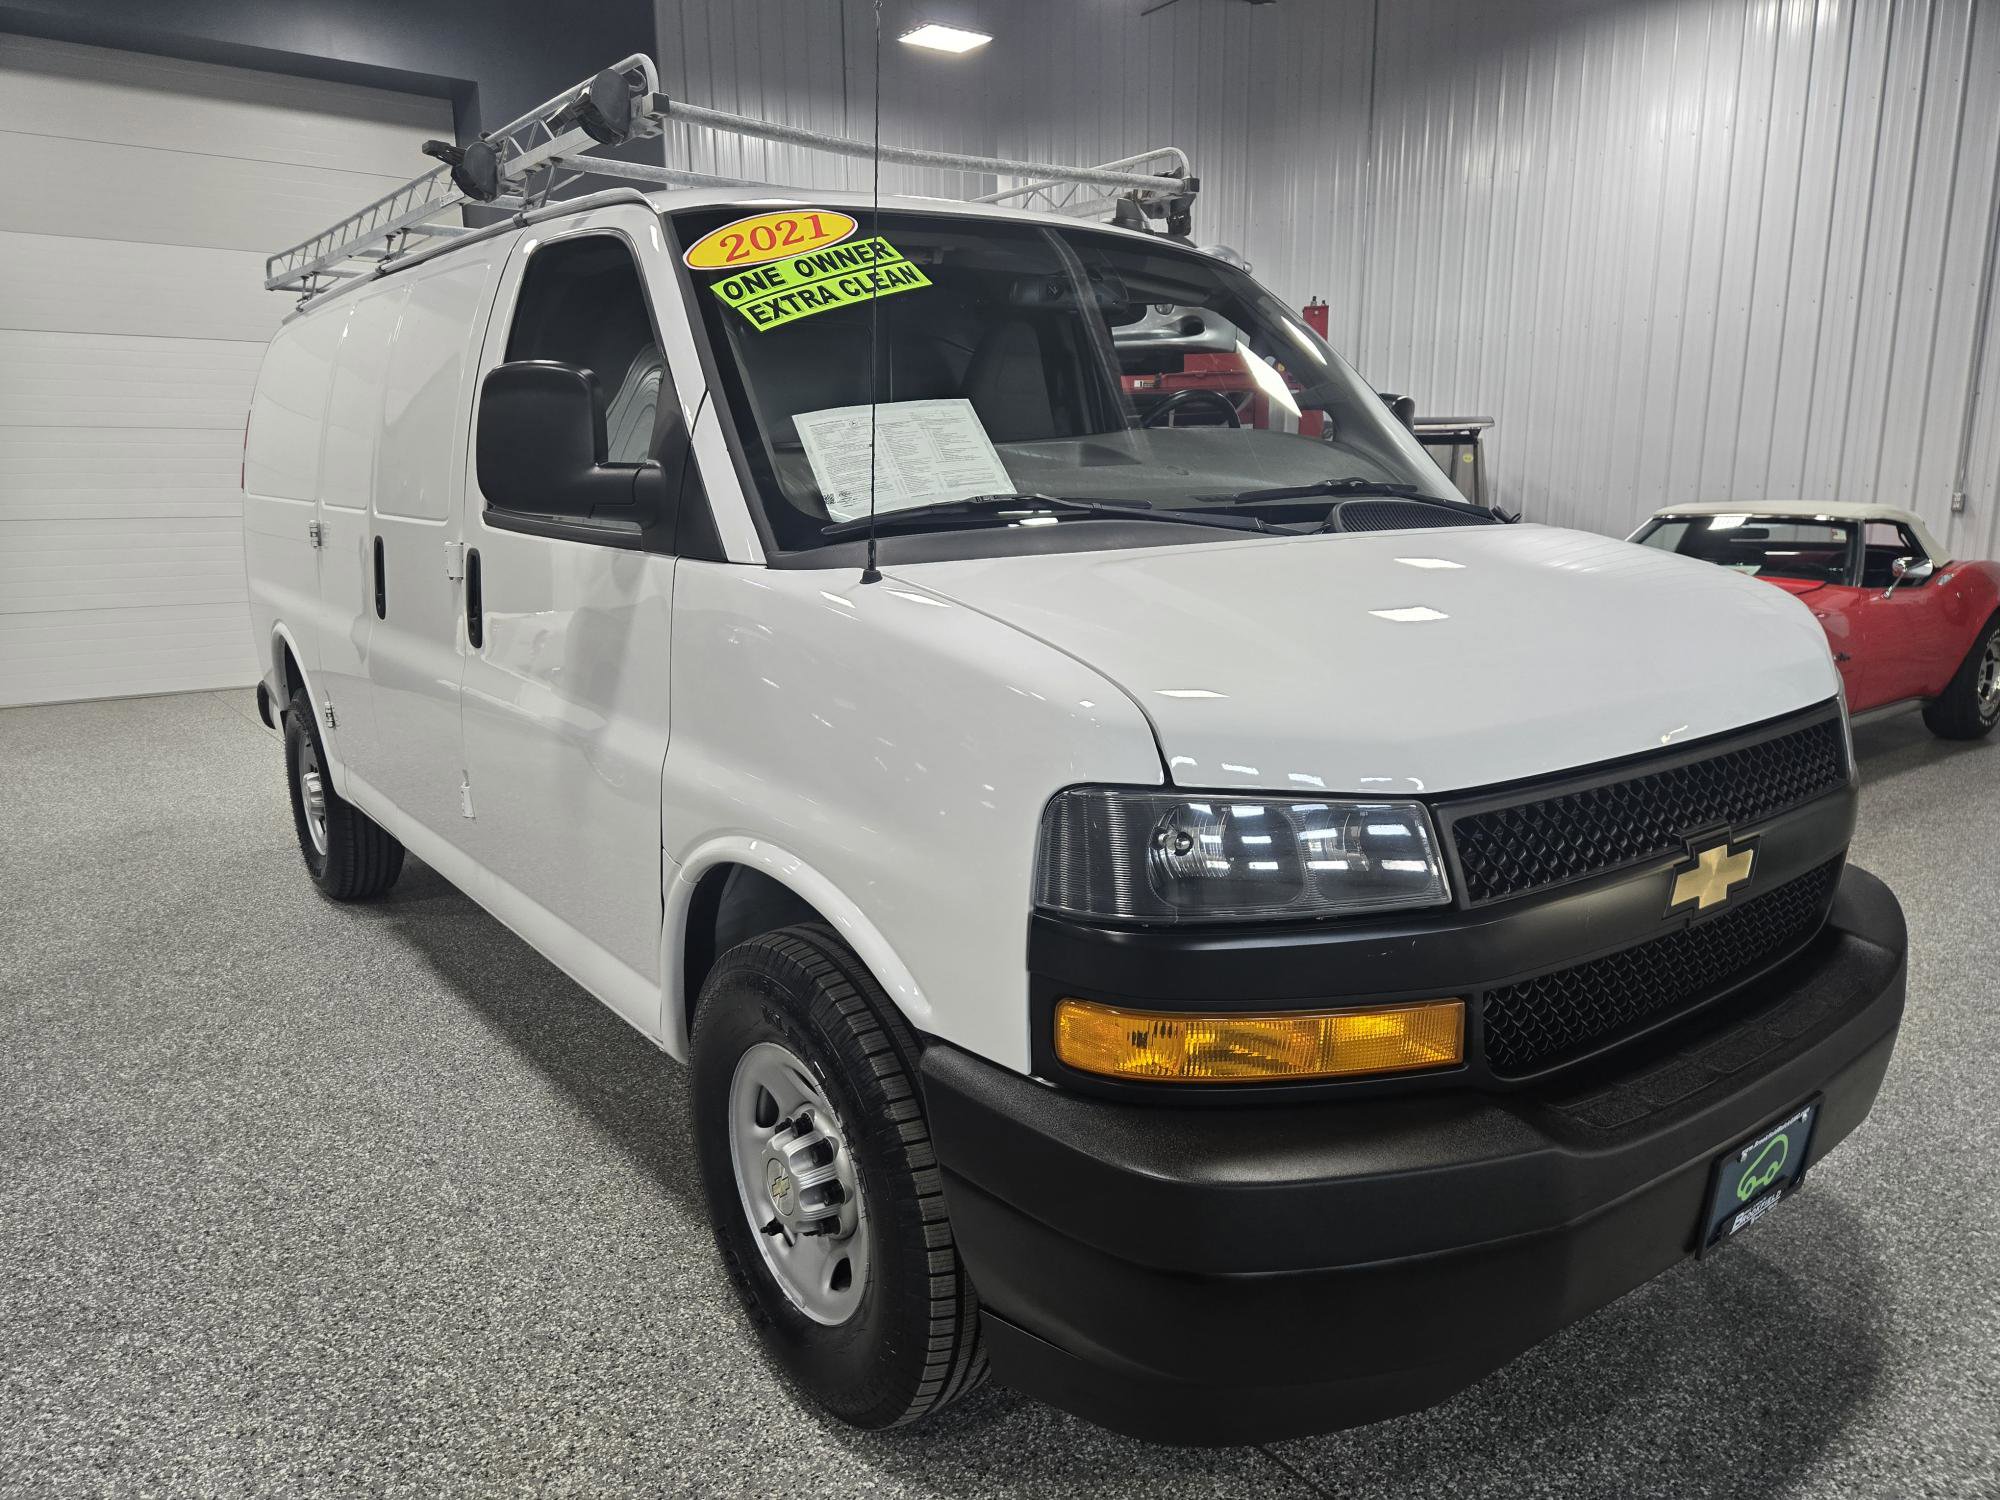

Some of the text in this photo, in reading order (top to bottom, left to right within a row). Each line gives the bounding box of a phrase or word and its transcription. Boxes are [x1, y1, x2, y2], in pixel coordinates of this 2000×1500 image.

[720, 214, 830, 263] 2021
[723, 240, 895, 301] ONE OWNER
[747, 264, 920, 326] EXTRA CLEAN
